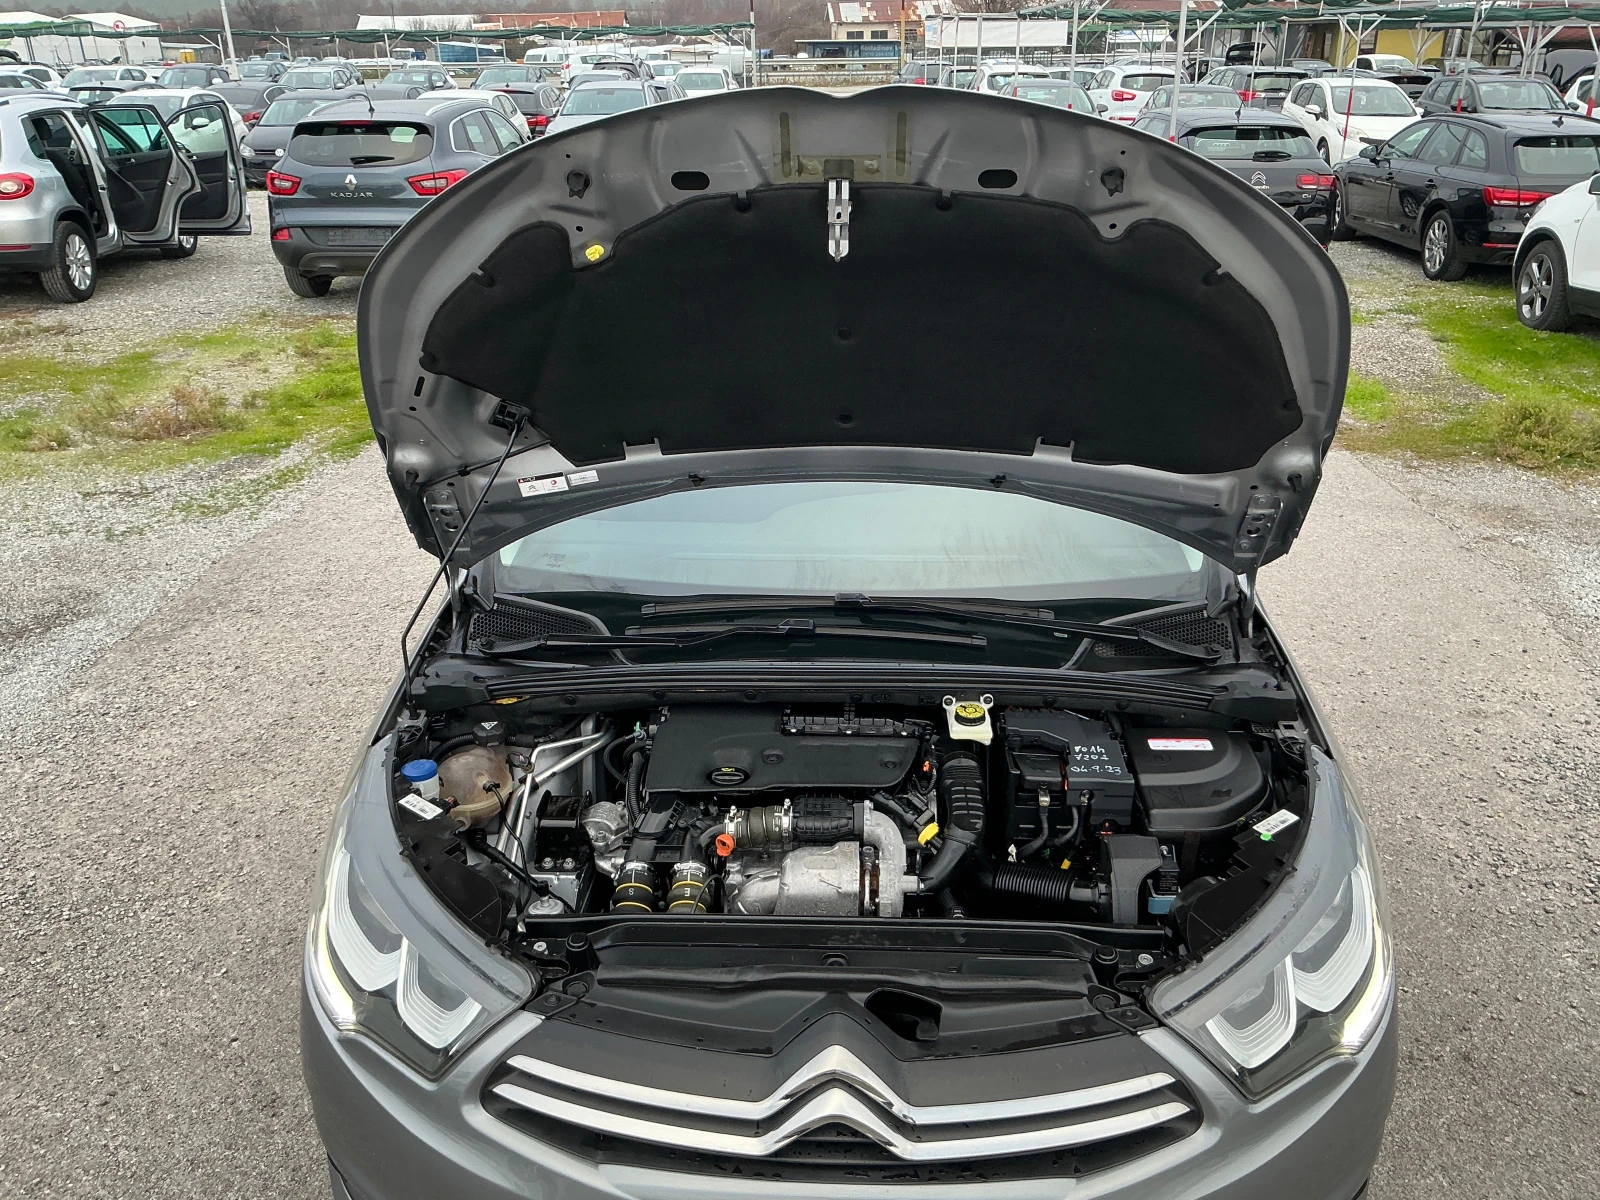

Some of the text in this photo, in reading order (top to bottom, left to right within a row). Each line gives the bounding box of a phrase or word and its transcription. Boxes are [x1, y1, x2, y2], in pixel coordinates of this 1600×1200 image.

[1090, 745, 1105, 753] Ah
[628, 888, 634, 896] S
[684, 887, 690, 896] E
